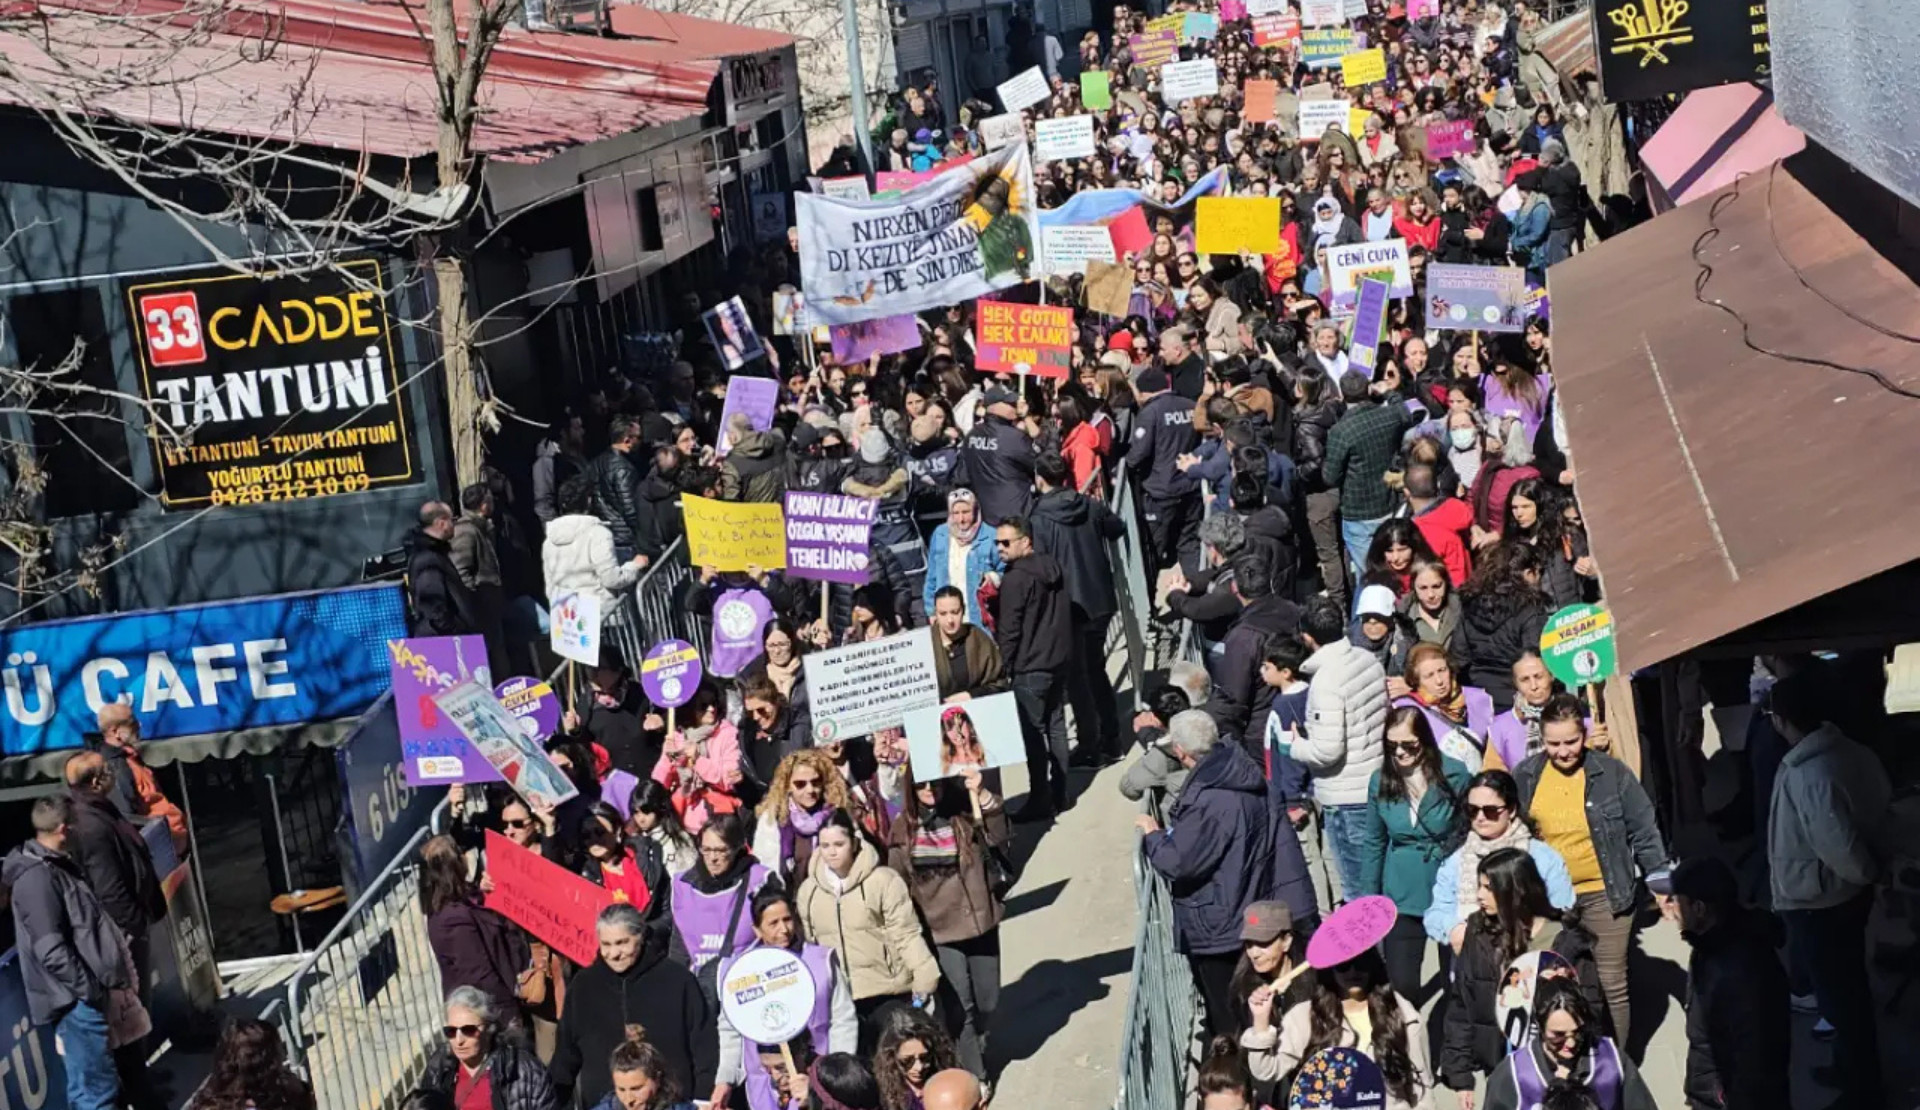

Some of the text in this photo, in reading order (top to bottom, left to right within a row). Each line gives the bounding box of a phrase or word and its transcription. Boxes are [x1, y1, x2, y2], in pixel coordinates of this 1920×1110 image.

[853, 206, 929, 243] NIRXÊN
[827, 249, 849, 272] DI
[884, 269, 908, 294] DE
[146, 290, 380, 351] 33 CADDE
[156, 345, 390, 428] TANTUNİ
[190, 435, 260, 463] TANTUNİ
[271, 433, 325, 454] TAVUK
[324, 420, 398, 447] TANTUNİ
[295, 451, 366, 479] TANTUNİ
[269, 480, 308, 501] 212
[314, 476, 338, 496] 10
[788, 494, 822, 516] KADIN
[81, 638, 298, 714] CAFE
[819, 679, 850, 692] KADIN
